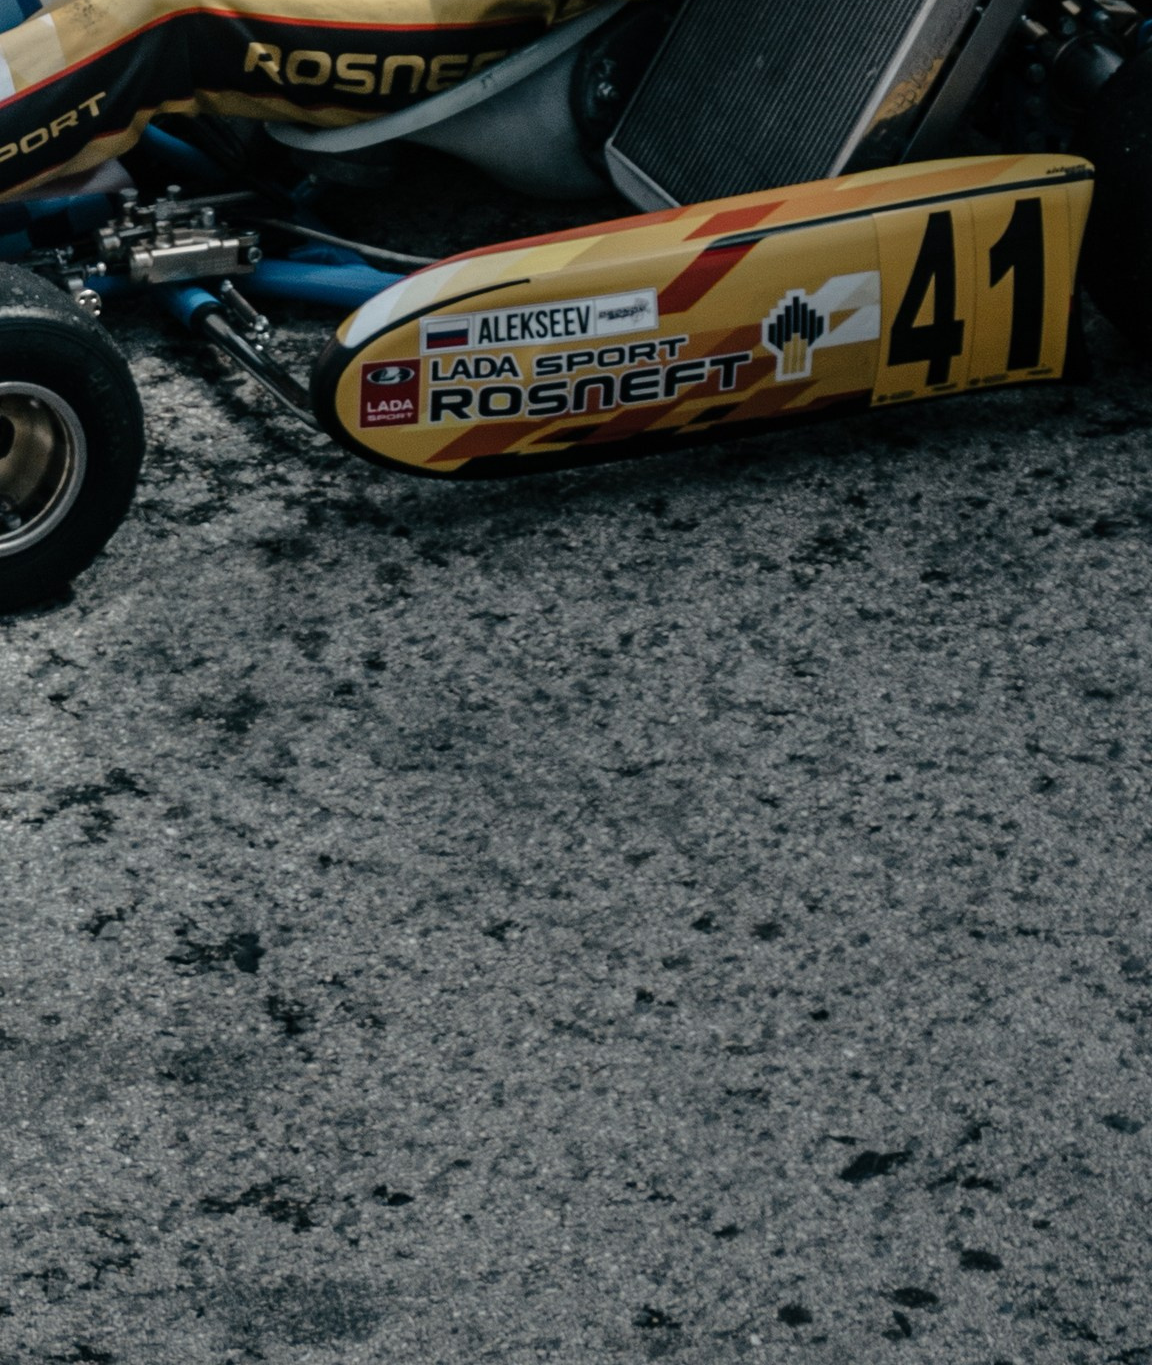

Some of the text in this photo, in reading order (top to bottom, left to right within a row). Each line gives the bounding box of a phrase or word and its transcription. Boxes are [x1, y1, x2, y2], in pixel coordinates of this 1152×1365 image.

[243, 40, 508, 96] ROSNE
[886, 196, 1046, 388] 41
[476, 304, 592, 346] ALEKSEEV
[430, 335, 690, 384] LADA SPORT
[366, 400, 415, 414] LADA
[428, 351, 751, 424] ROSNEFT
[365, 412, 414, 423] SPORT
